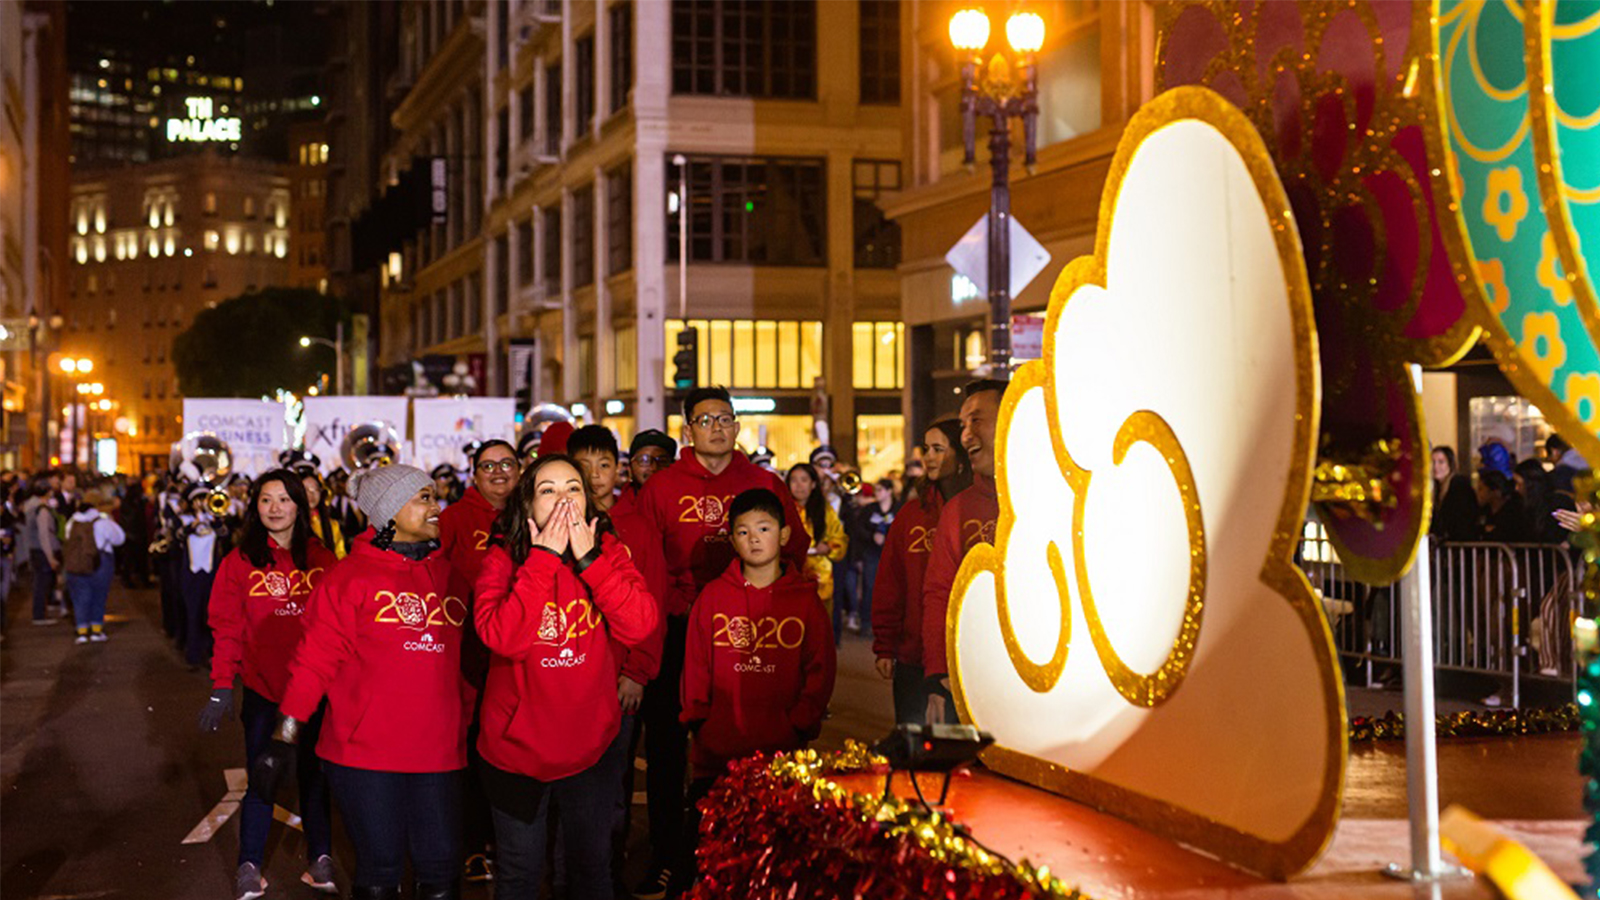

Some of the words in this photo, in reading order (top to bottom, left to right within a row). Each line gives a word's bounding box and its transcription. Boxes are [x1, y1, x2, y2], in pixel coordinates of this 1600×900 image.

[167, 117, 241, 142] PALACE
[198, 414, 271, 429] COMCAST
[217, 431, 271, 444] SINESS
[374, 590, 468, 627] 2020
[713, 613, 805, 649] 2020
[403, 641, 445, 653] COMCAST
[541, 653, 586, 668] COMCAST
